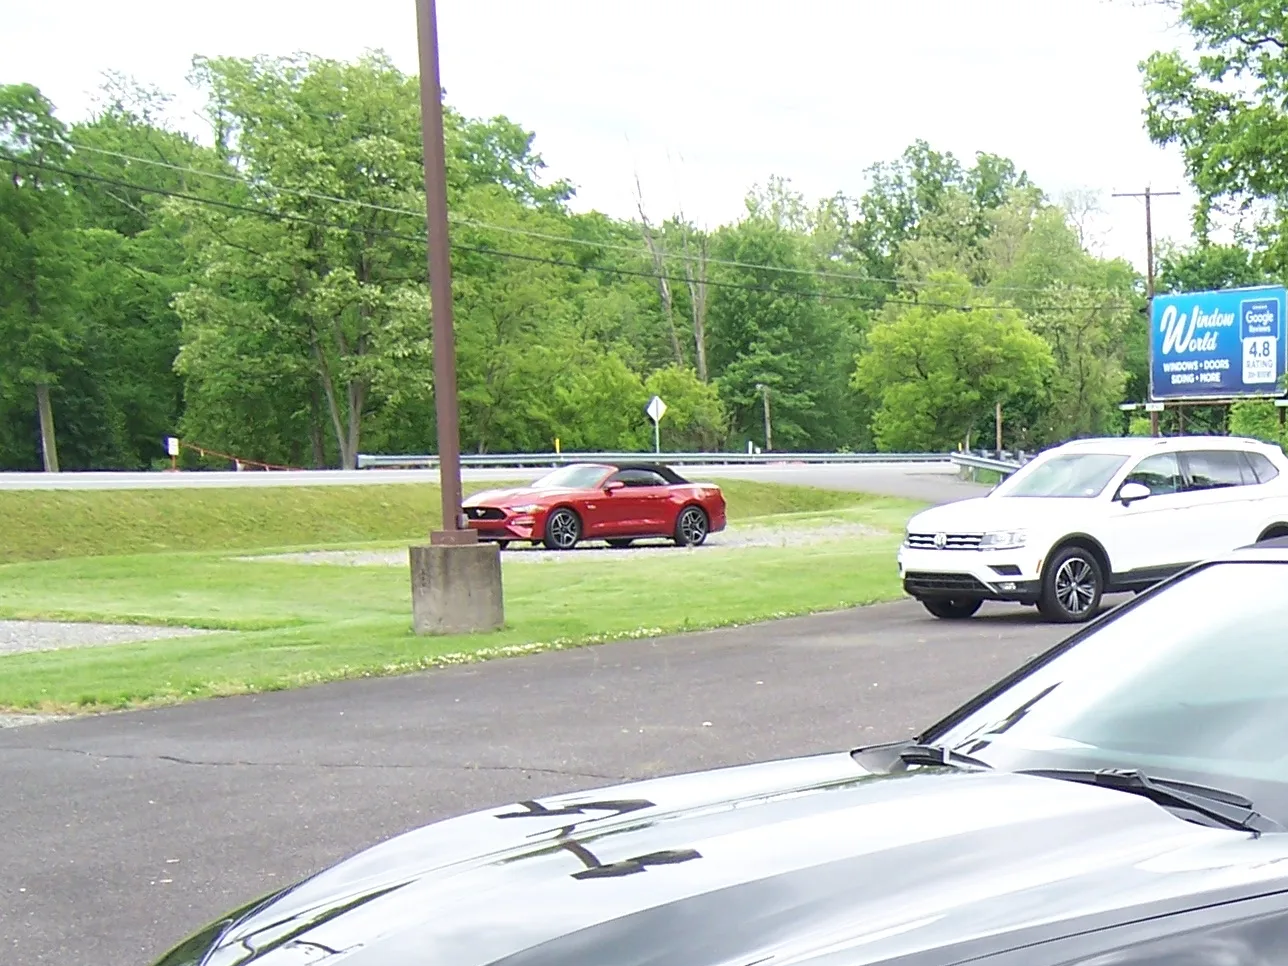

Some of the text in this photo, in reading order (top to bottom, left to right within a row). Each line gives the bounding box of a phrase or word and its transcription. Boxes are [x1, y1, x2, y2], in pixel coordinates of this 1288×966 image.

[1245, 310, 1274, 326] Google
[1159, 304, 1235, 355] Window
[1248, 341, 1270, 358] 4.8
[1162, 359, 1230, 373] WINDOWS DOORS
[1246, 359, 1273, 369] RATING
[1199, 372, 1221, 383] MORE
